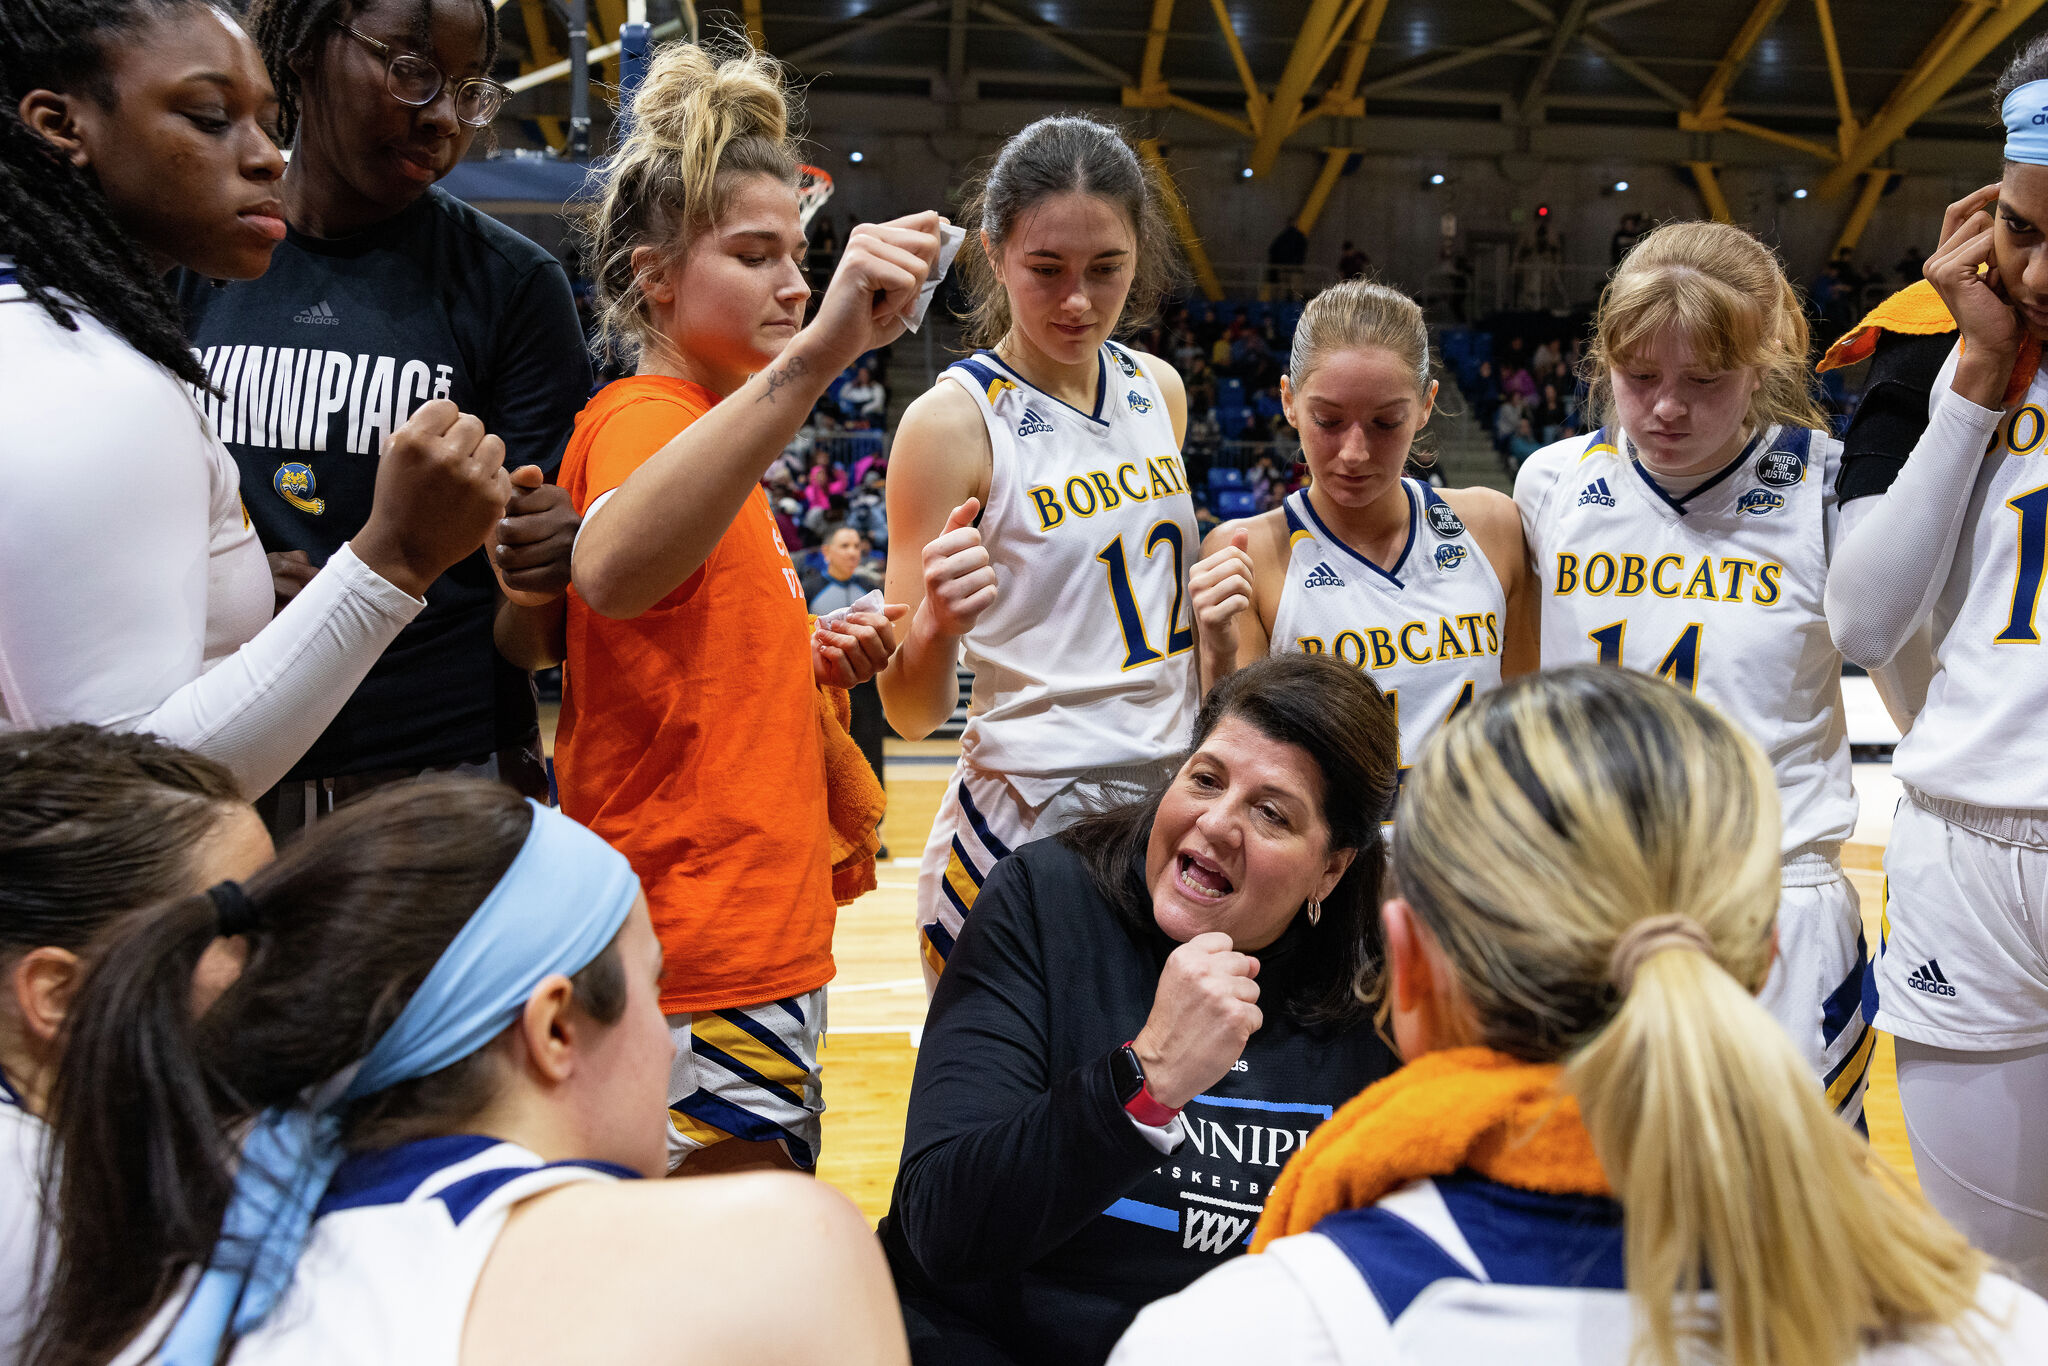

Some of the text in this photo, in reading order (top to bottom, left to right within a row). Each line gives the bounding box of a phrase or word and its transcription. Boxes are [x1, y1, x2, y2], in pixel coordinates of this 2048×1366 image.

[293, 314, 340, 326] adidas
[186, 344, 430, 455] UINNIPIAC
[1018, 421, 1054, 437] adidas
[1768, 454, 1797, 466] UNITED
[1772, 462, 1789, 472] FOR
[1762, 469, 1796, 482] JUSTICE
[1735, 494, 1785, 515] MAAC
[1440, 514, 1454, 522] FOR
[1436, 521, 1463, 530] JUSTICE
[1434, 545, 1468, 571] MAAC
[1304, 576, 1346, 589] adidas
[1553, 551, 1784, 606] BOBCATS
[1096, 519, 1195, 672] 12
[1907, 975, 1957, 997] adidas
